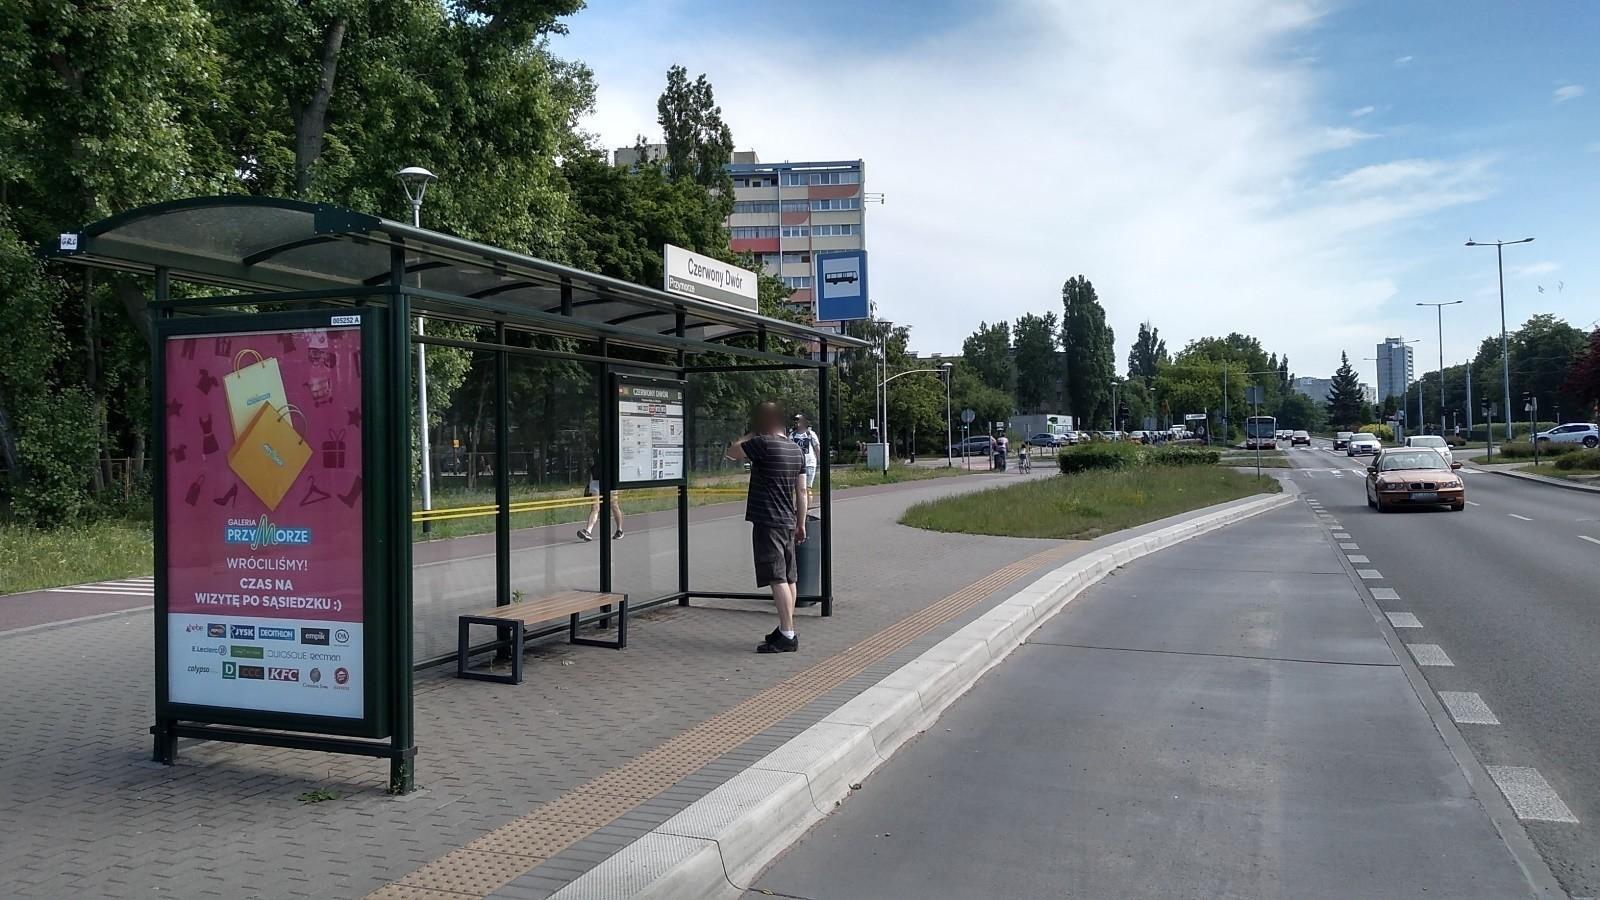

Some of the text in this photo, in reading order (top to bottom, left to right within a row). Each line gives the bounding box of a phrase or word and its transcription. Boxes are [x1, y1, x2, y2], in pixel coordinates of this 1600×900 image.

[688, 258, 742, 290] Czerwony Dwór
[669, 278, 696, 293] Przymorze
[227, 514, 308, 550] PRZYMORZE
[226, 556, 308, 571] WRÓCILIŚMY!
[240, 578, 293, 590] CZAS NA
[194, 592, 240, 608] WIZYTĘ
[242, 595, 260, 606] PO
[262, 596, 331, 610] SĄSIEDZKU
[234, 628, 254, 636] JYSK
[260, 630, 293, 638] DECATHLON
[304, 632, 326, 640] empik
[188, 664, 210, 674] calypso
[270, 668, 298, 680] KFC
